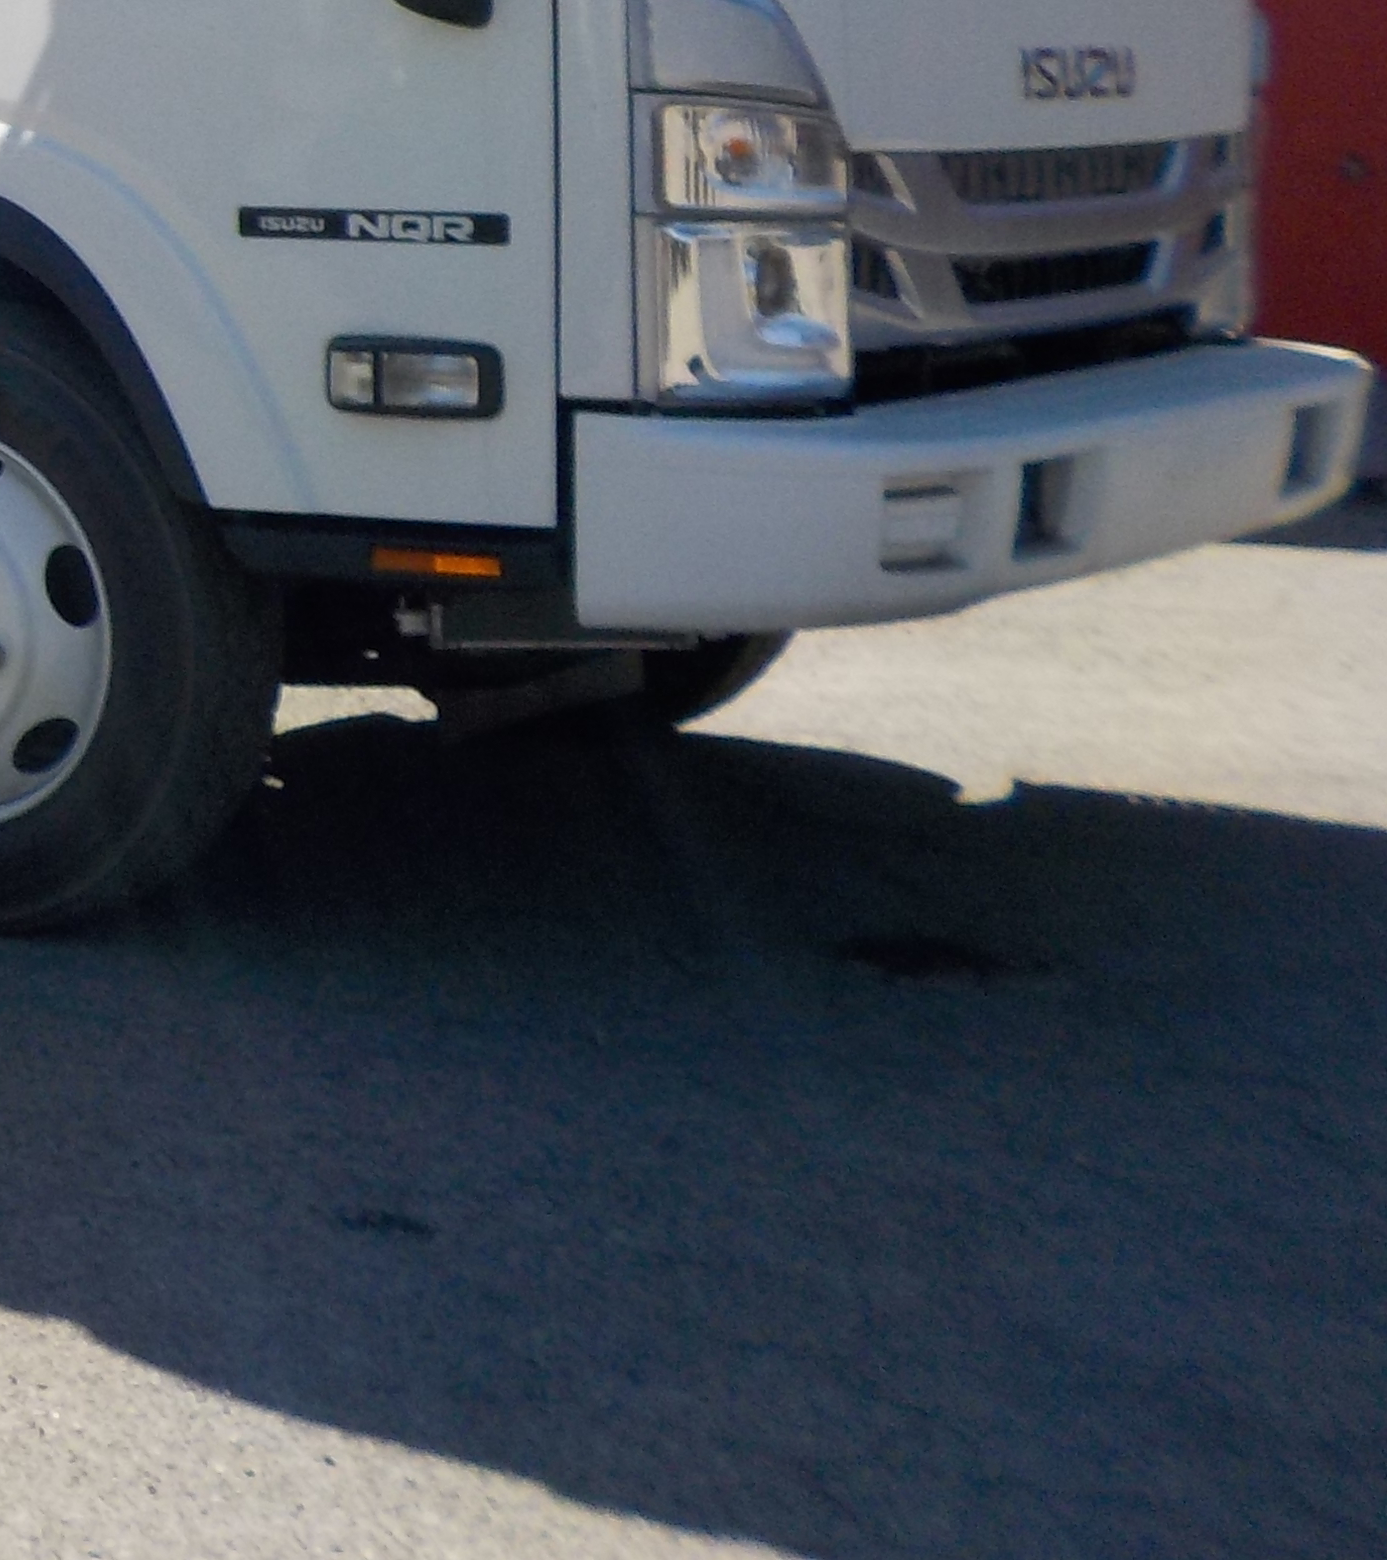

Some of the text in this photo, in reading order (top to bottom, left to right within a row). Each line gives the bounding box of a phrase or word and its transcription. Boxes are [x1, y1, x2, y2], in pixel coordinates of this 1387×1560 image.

[1018, 45, 1136, 98] ISUZU
[259, 213, 475, 241] ISUZU NQR
